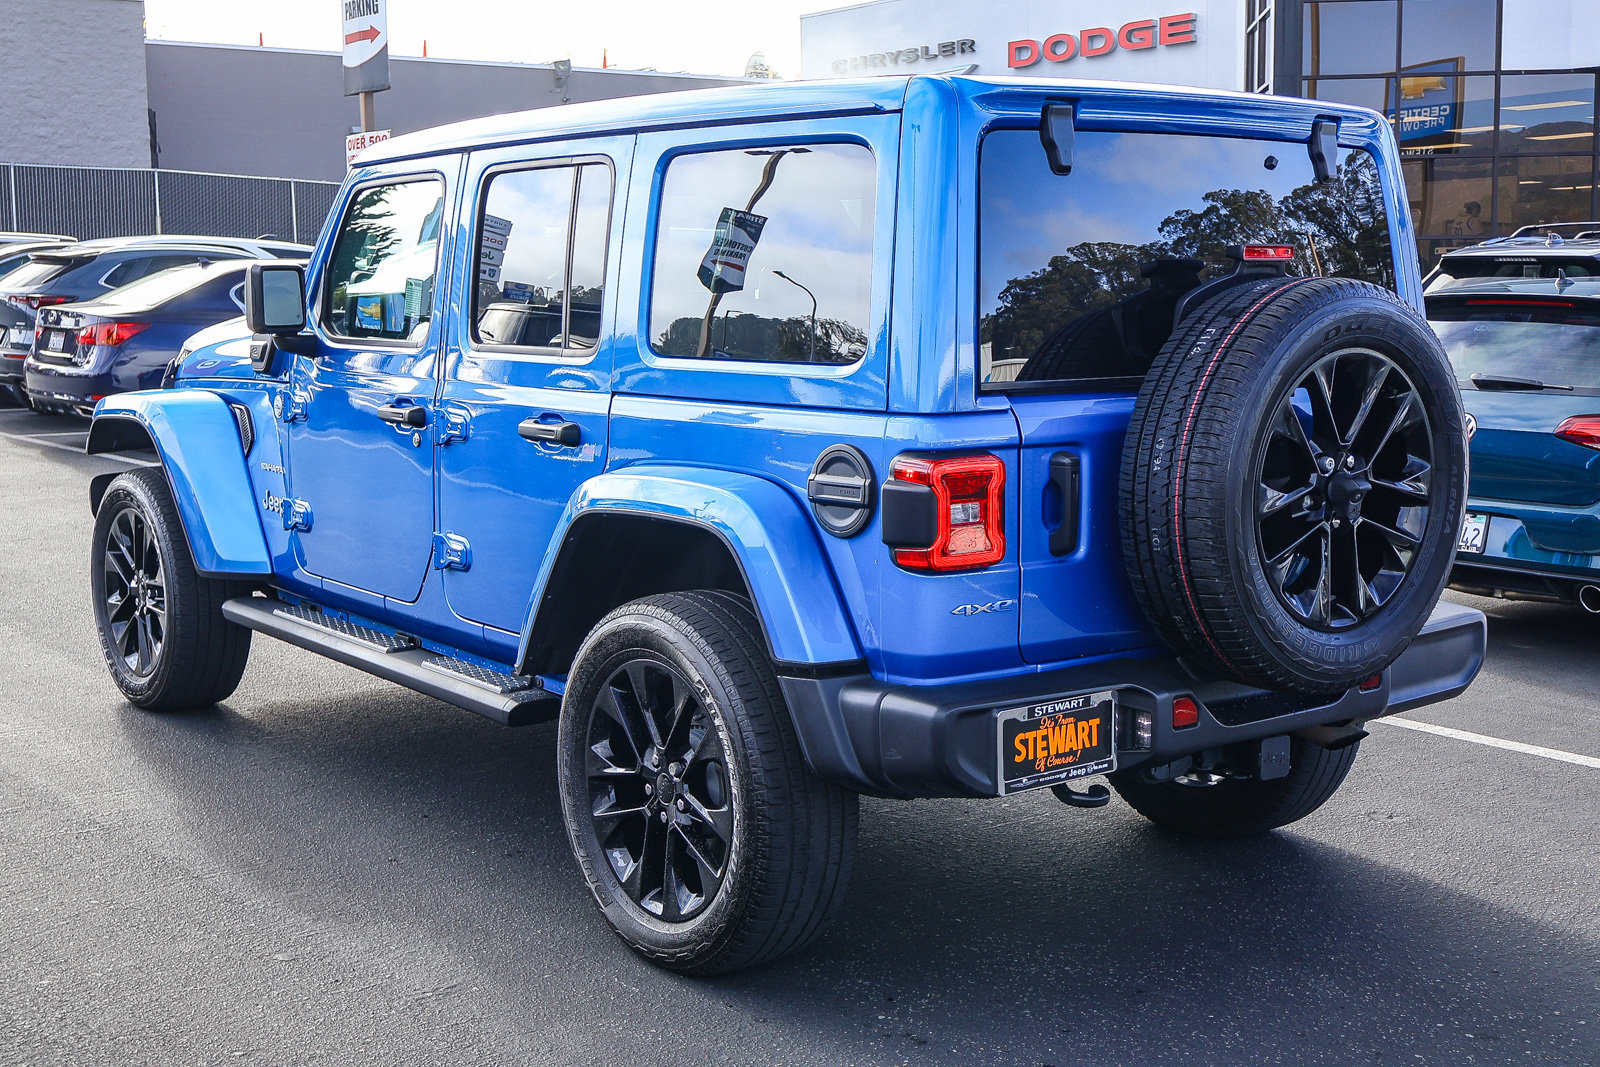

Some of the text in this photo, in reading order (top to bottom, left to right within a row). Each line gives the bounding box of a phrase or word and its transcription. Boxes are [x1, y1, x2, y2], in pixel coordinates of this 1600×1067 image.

[344, 0, 379, 21] PARKING
[1007, 12, 1197, 69] DODGE
[831, 38, 976, 76] CHRYSLER
[348, 137, 366, 151] OVER
[839, 488, 857, 497] FUEL
[1248, 549, 1379, 663] BRIDGESTONE
[1034, 698, 1085, 717] STEWART
[1056, 714, 1076, 727] From
[1014, 717, 1101, 763] STEWART
[1035, 757, 1047, 772] Of
[1069, 767, 1086, 777] Jeep
